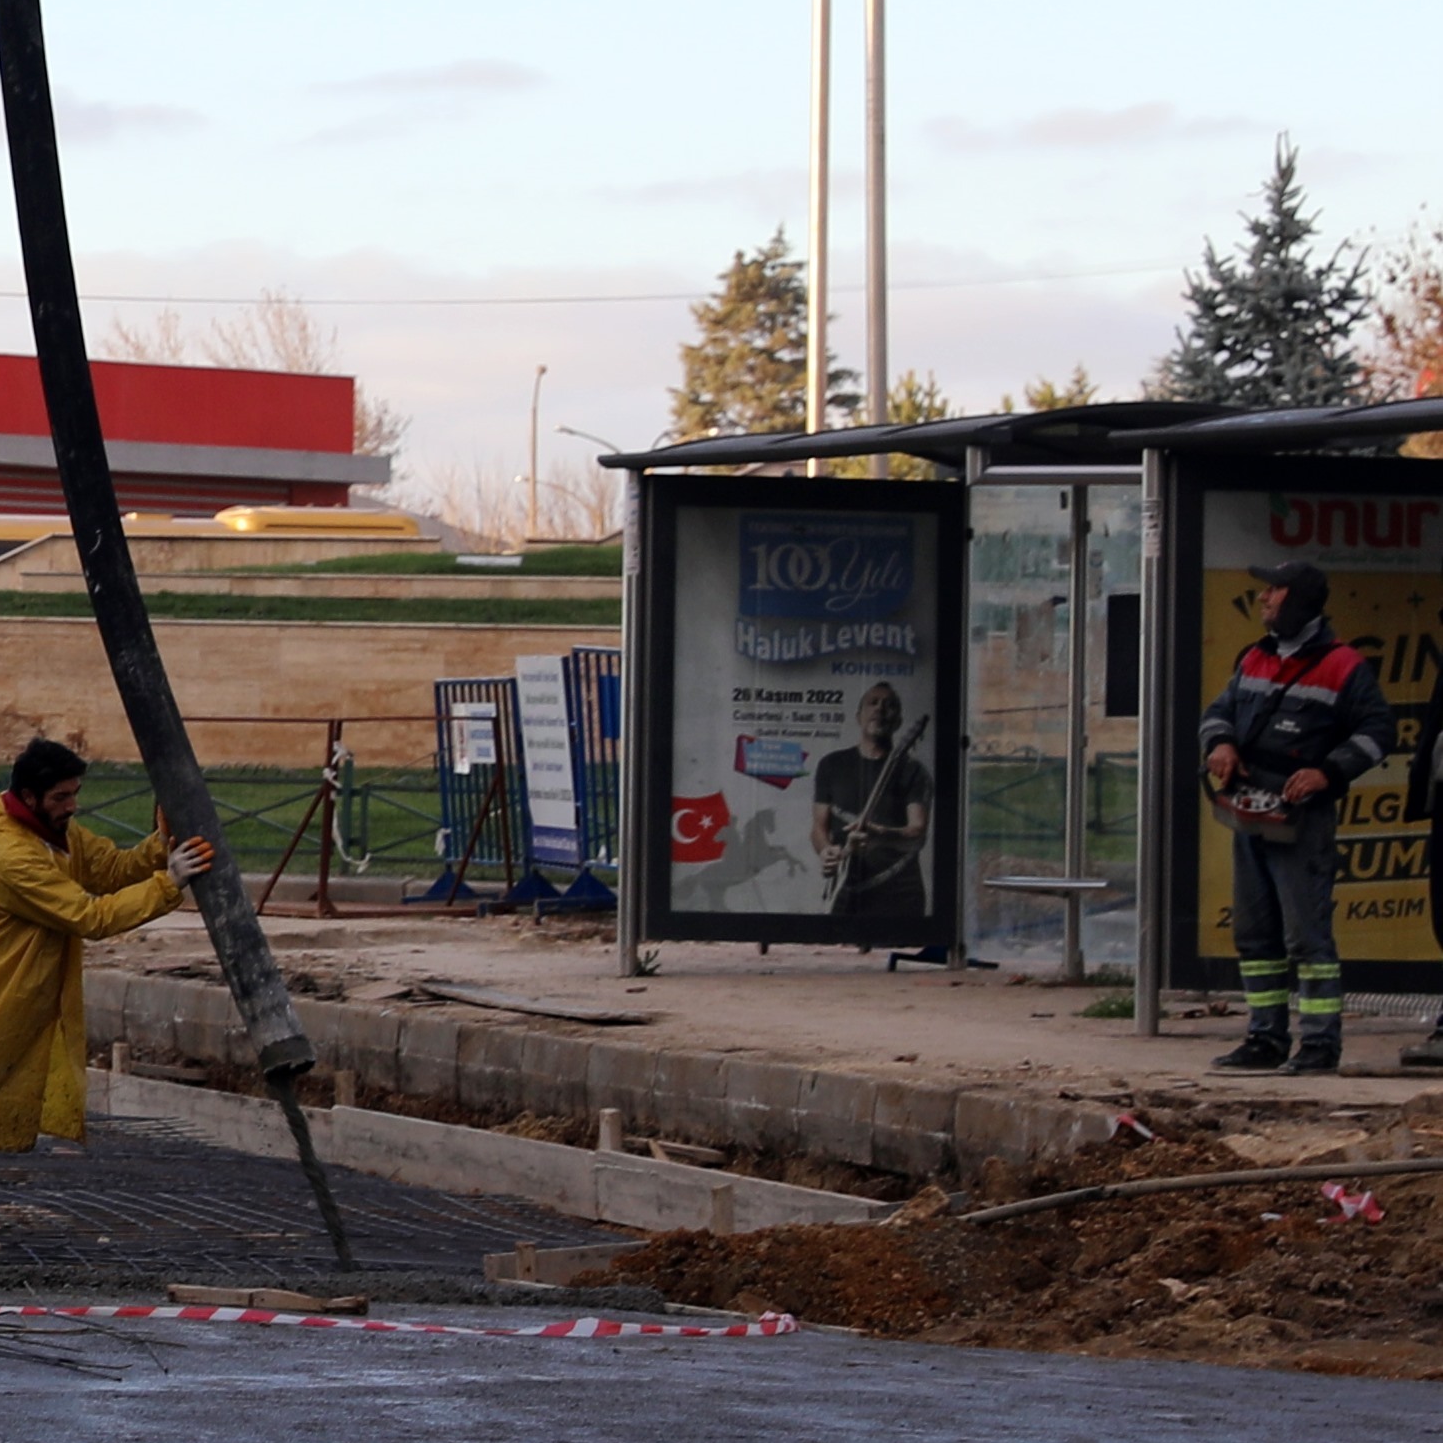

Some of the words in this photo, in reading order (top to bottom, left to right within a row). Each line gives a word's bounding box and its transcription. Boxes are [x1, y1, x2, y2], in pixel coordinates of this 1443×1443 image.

[736, 621, 815, 660] Haluk
[821, 622, 916, 655] Levent
[755, 688, 803, 704] Kasım
[807, 689, 844, 704] 2022
[1347, 898, 1426, 920] KASIM
